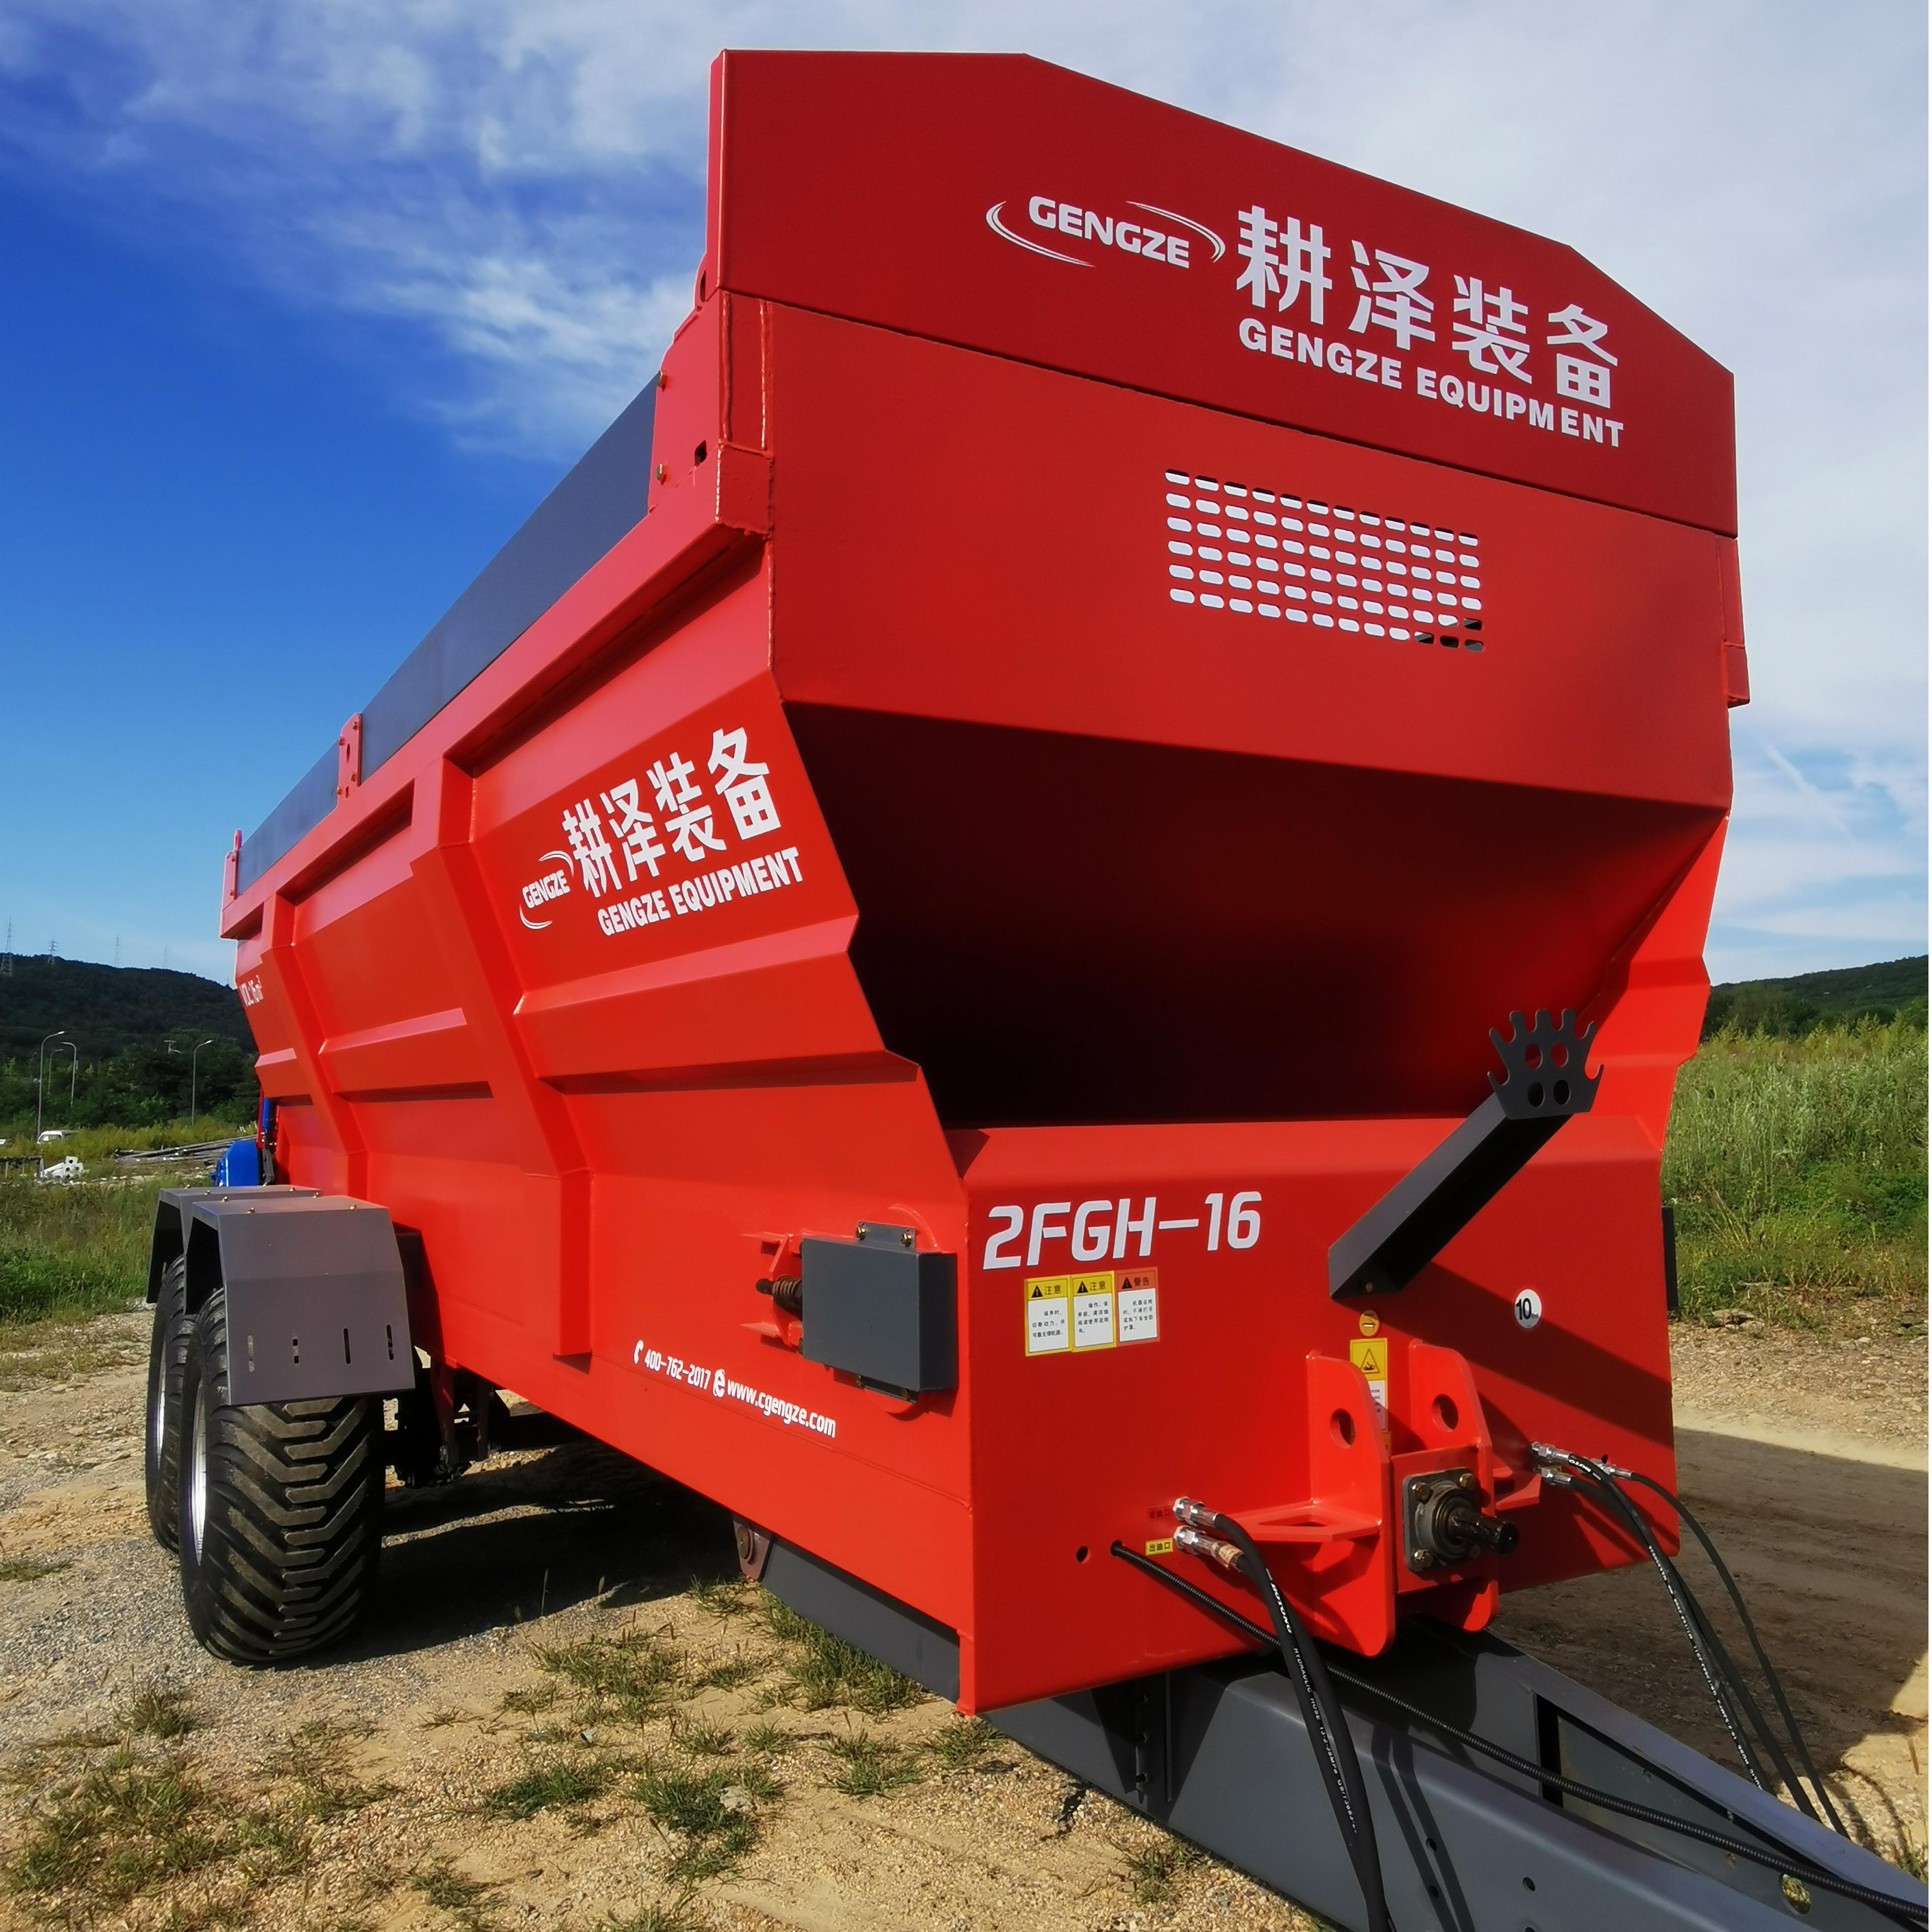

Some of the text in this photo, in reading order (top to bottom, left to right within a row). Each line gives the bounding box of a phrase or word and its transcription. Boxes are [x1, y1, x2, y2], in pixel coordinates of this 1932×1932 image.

[1029, 196, 1189, 268] GENGZE
[1237, 205, 1618, 408] 耕泽装备
[1239, 318, 1623, 447] GENGZE EQUIPMENT
[564, 728, 781, 898] 耕泽装备
[522, 869, 570, 908] GENGZE
[598, 847, 802, 936] GENGZE EQUIPMENT
[983, 1191, 1261, 1269] 2FGH-16
[1044, 1285, 1062, 1295] 注意
[1089, 1280, 1106, 1291] 注意
[1134, 1277, 1150, 1286] 警告
[1516, 1298, 1532, 1320] 10
[645, 1349, 711, 1390] 400-762-2017
[728, 1379, 836, 1438] www.cgengze.com
[1149, 1542, 1170, 1552] 出油口
[1294, 1648, 1312, 1693] HYDRAULIC
[1310, 1698, 1321, 1720] HOSE
